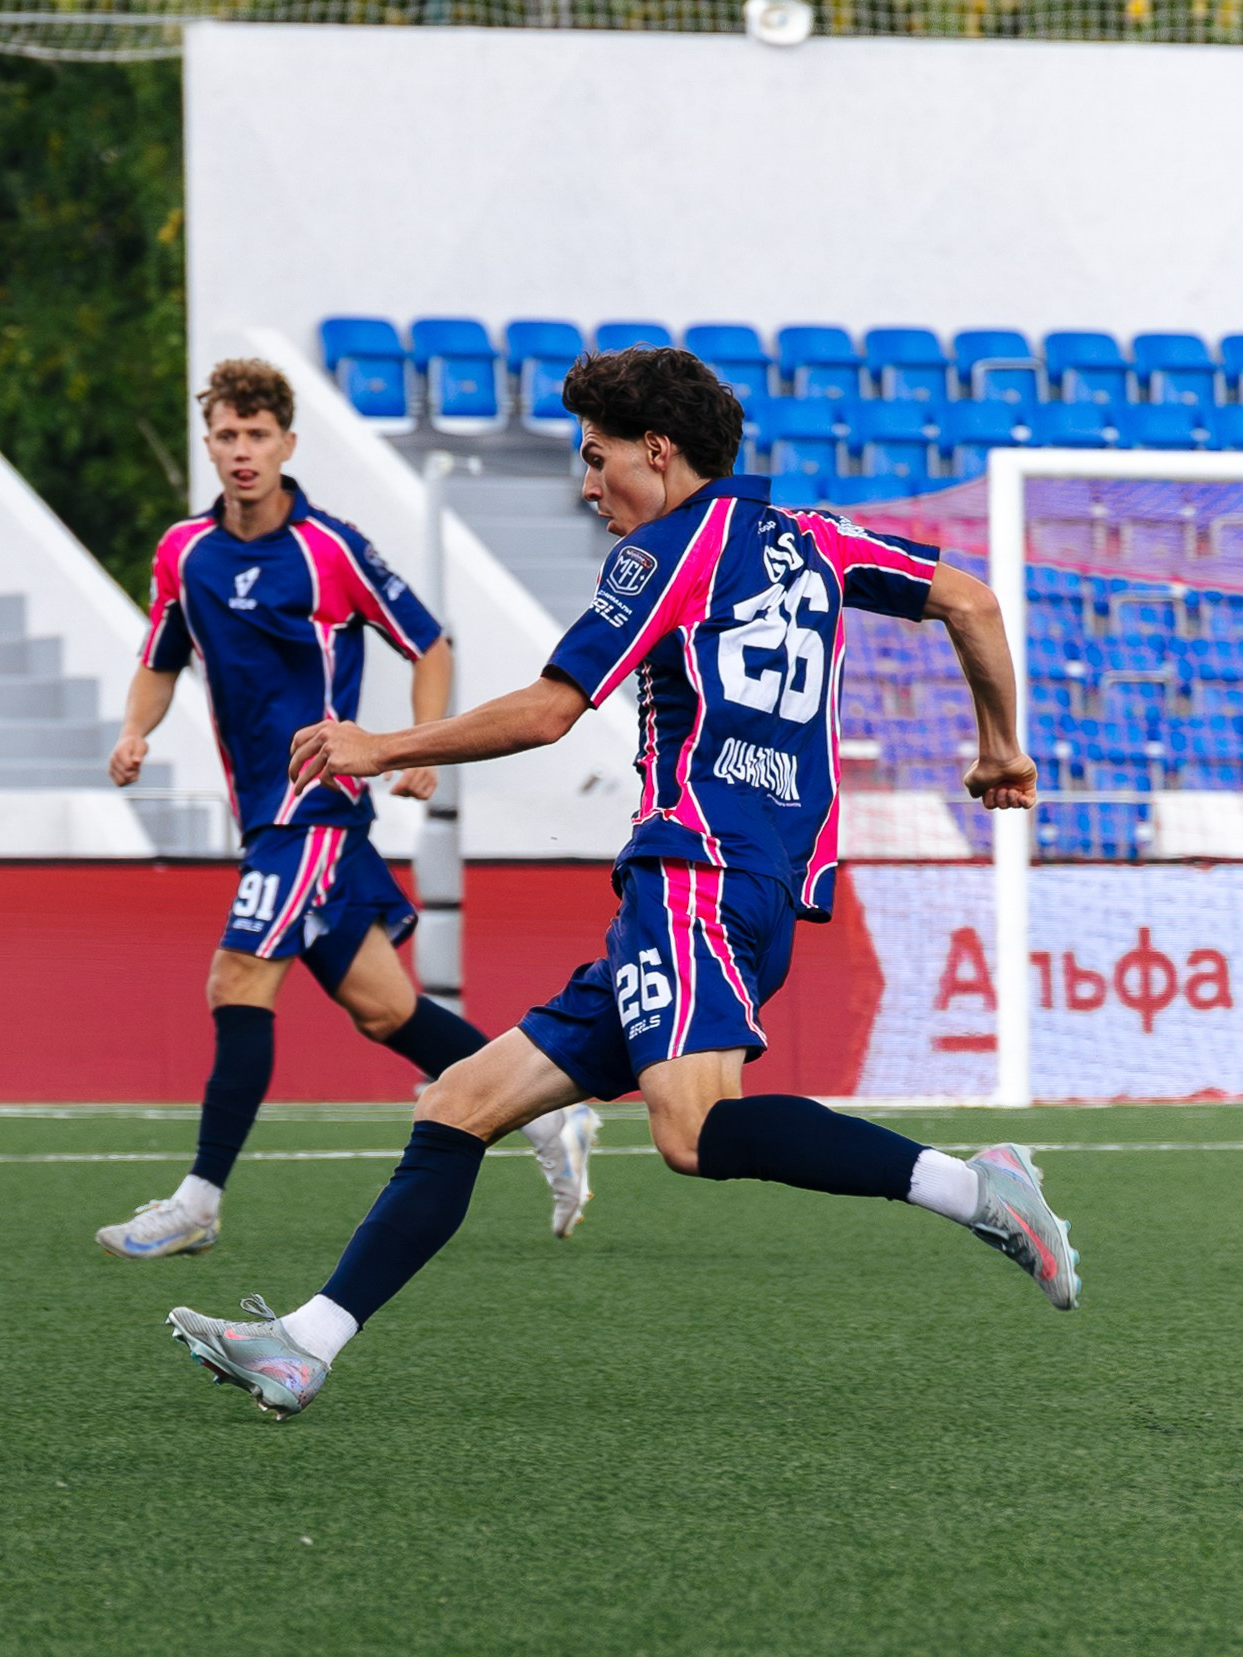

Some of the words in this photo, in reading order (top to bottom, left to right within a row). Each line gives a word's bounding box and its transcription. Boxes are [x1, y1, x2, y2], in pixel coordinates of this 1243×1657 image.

[717, 569, 829, 724] 26
[233, 870, 280, 921] 91
[616, 947, 673, 1028] 26
